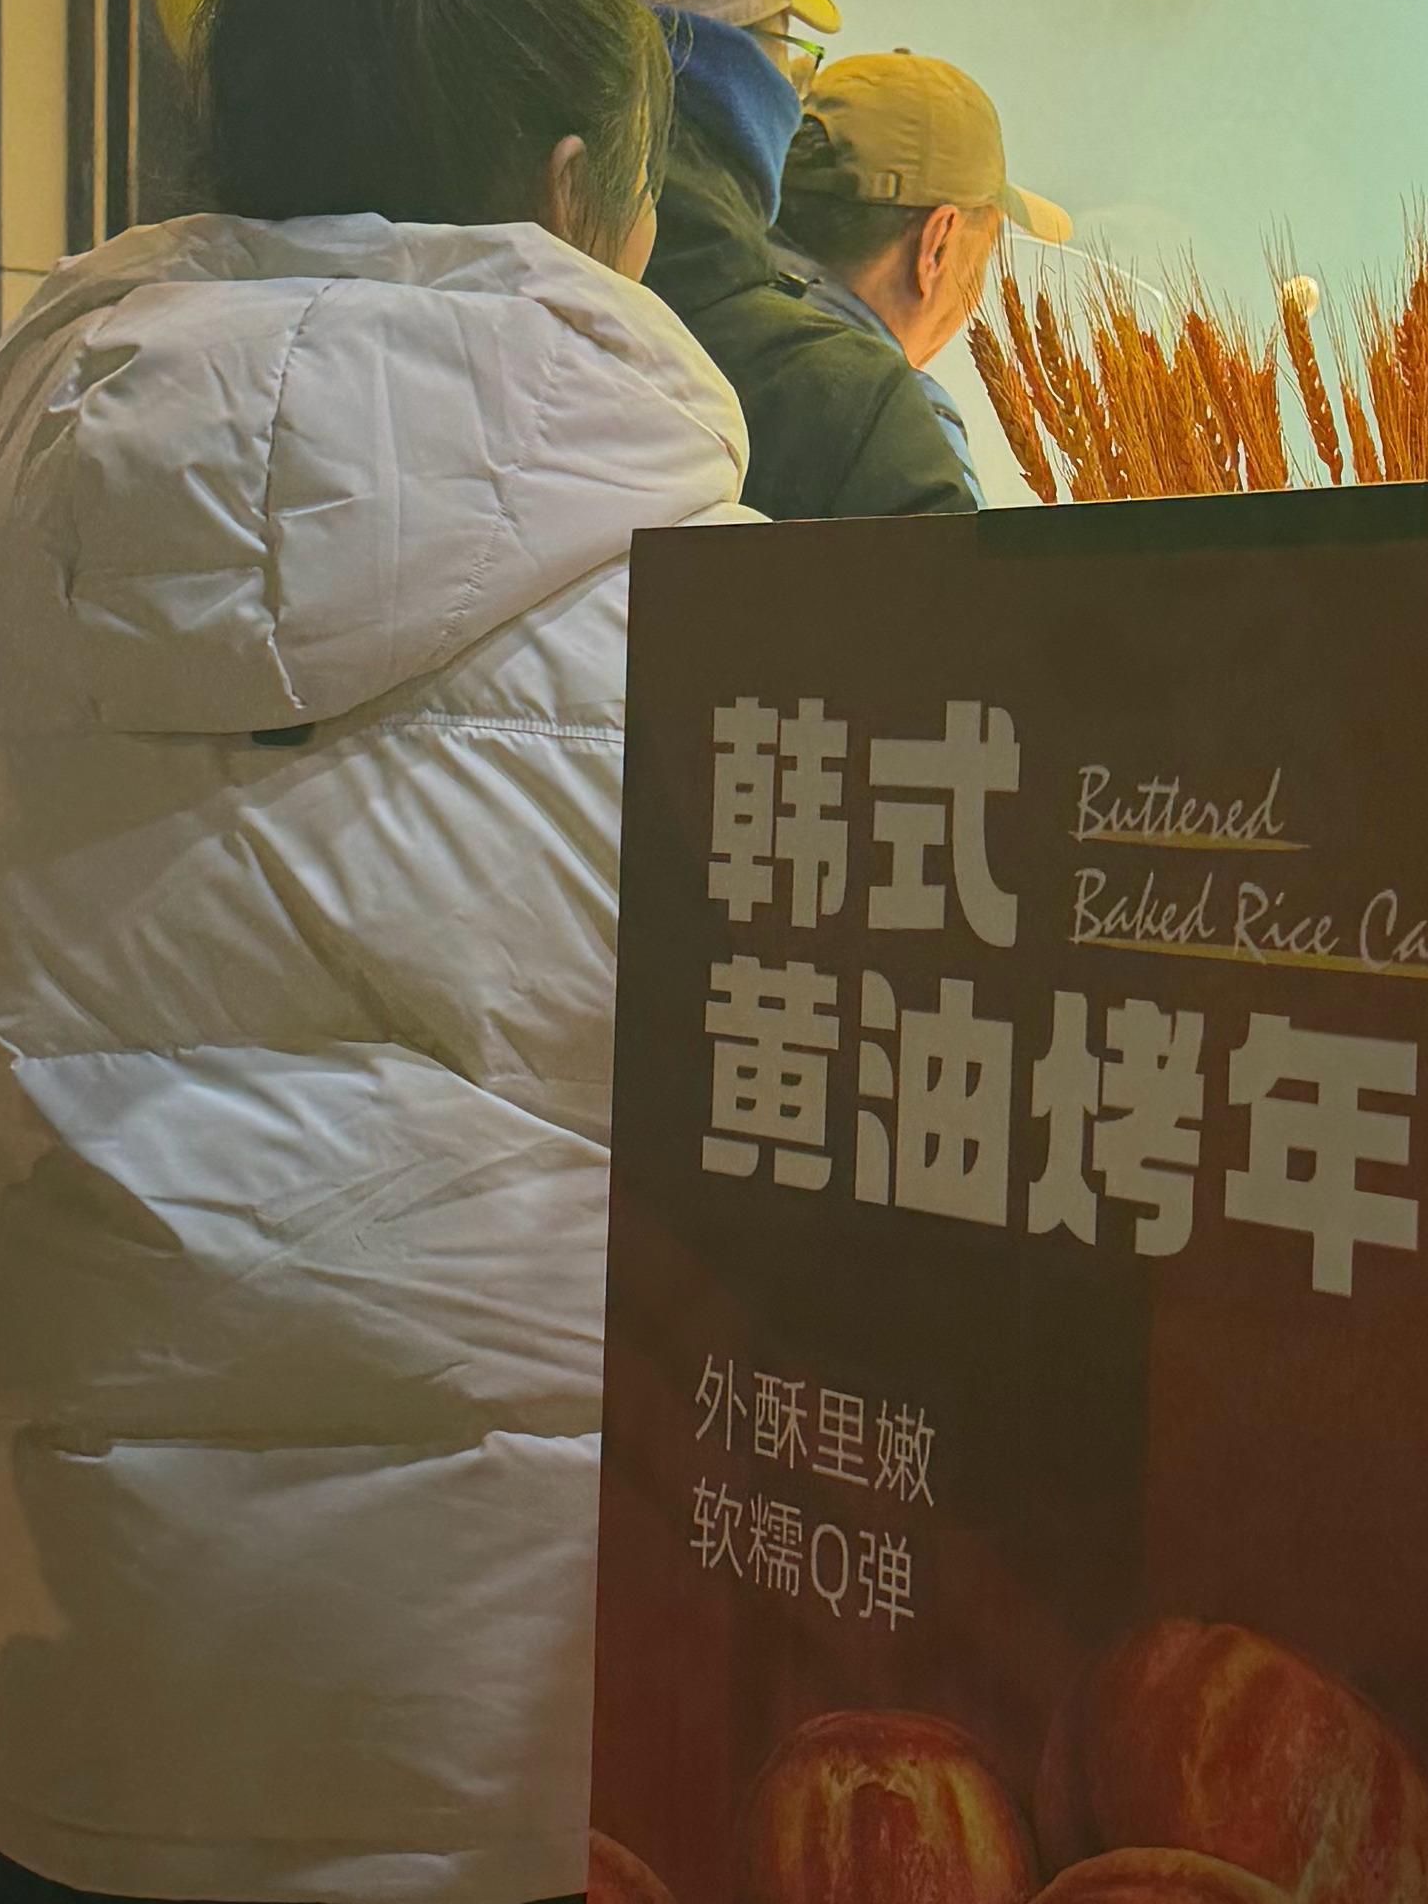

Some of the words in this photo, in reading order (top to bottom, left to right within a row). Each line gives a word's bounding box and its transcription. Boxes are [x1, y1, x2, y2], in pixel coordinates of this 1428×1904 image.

[708, 696, 1020, 949] 韩式
[1074, 762, 1285, 844] Buttered
[1072, 865, 1217, 946] Baked
[1233, 881, 1340, 964] Rice
[694, 1353, 936, 1508] 外酥里嫩
[689, 1475, 915, 1632] 软糯Q弹
